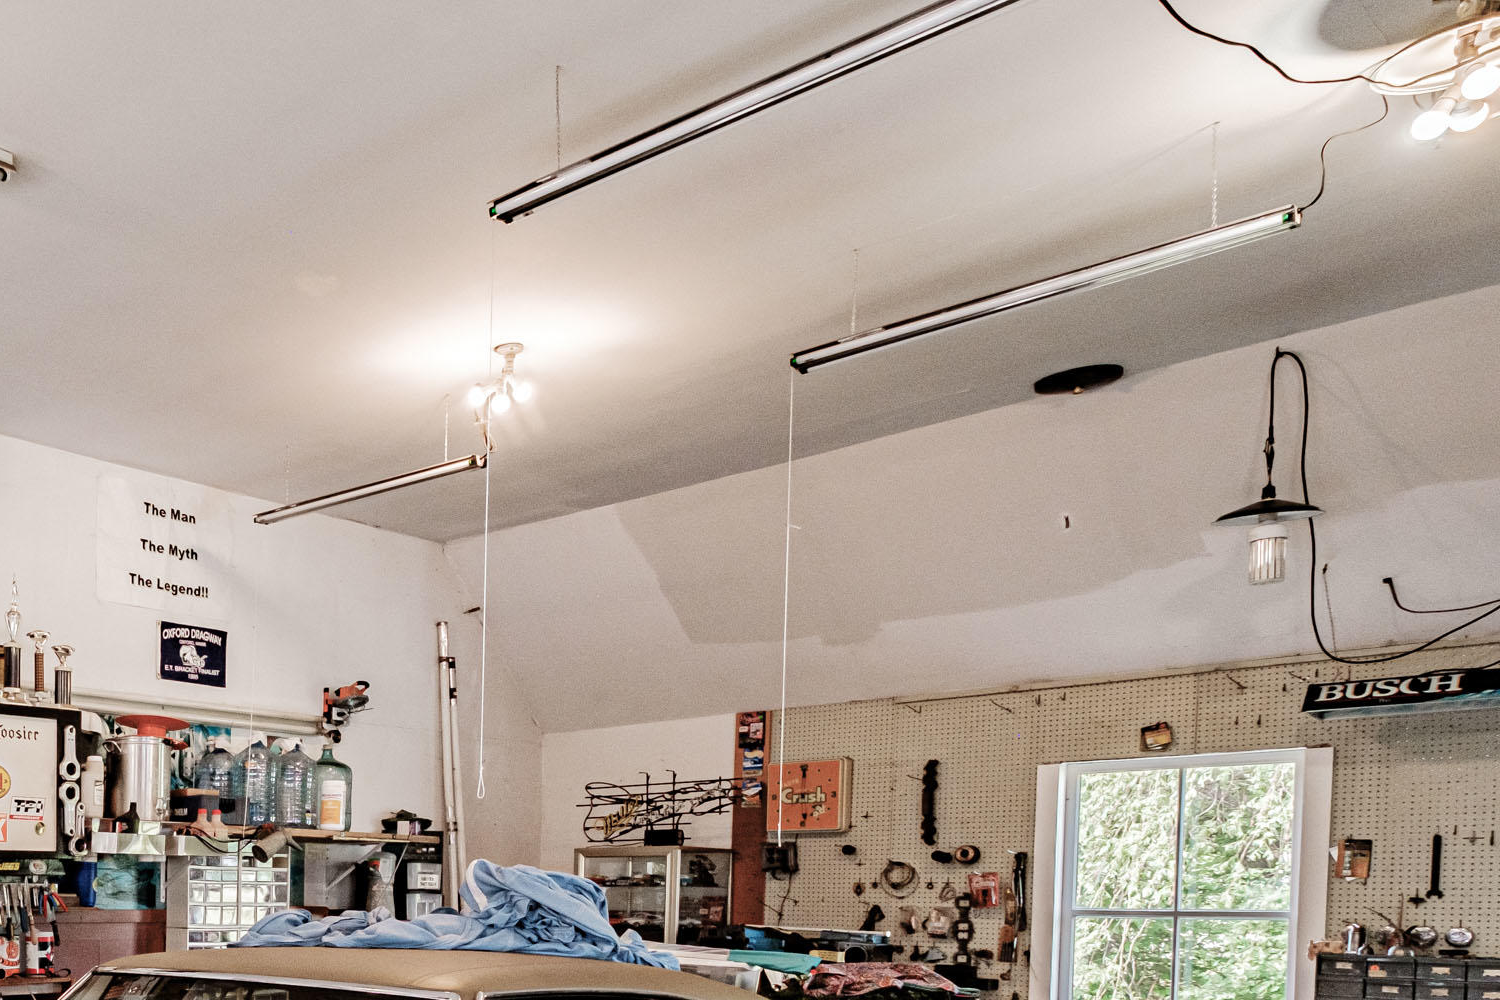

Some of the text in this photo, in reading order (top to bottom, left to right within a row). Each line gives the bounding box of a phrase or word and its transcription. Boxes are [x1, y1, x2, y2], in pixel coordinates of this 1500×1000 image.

[143, 502, 197, 525] The Man
[140, 538, 198, 561] The Myth
[129, 572, 209, 599] The Legend!!
[162, 628, 190, 639] OXFORD
[190, 628, 222, 646] DRAGWAY
[1314, 673, 1466, 702] BUSCH
[781, 785, 826, 804] Crush
